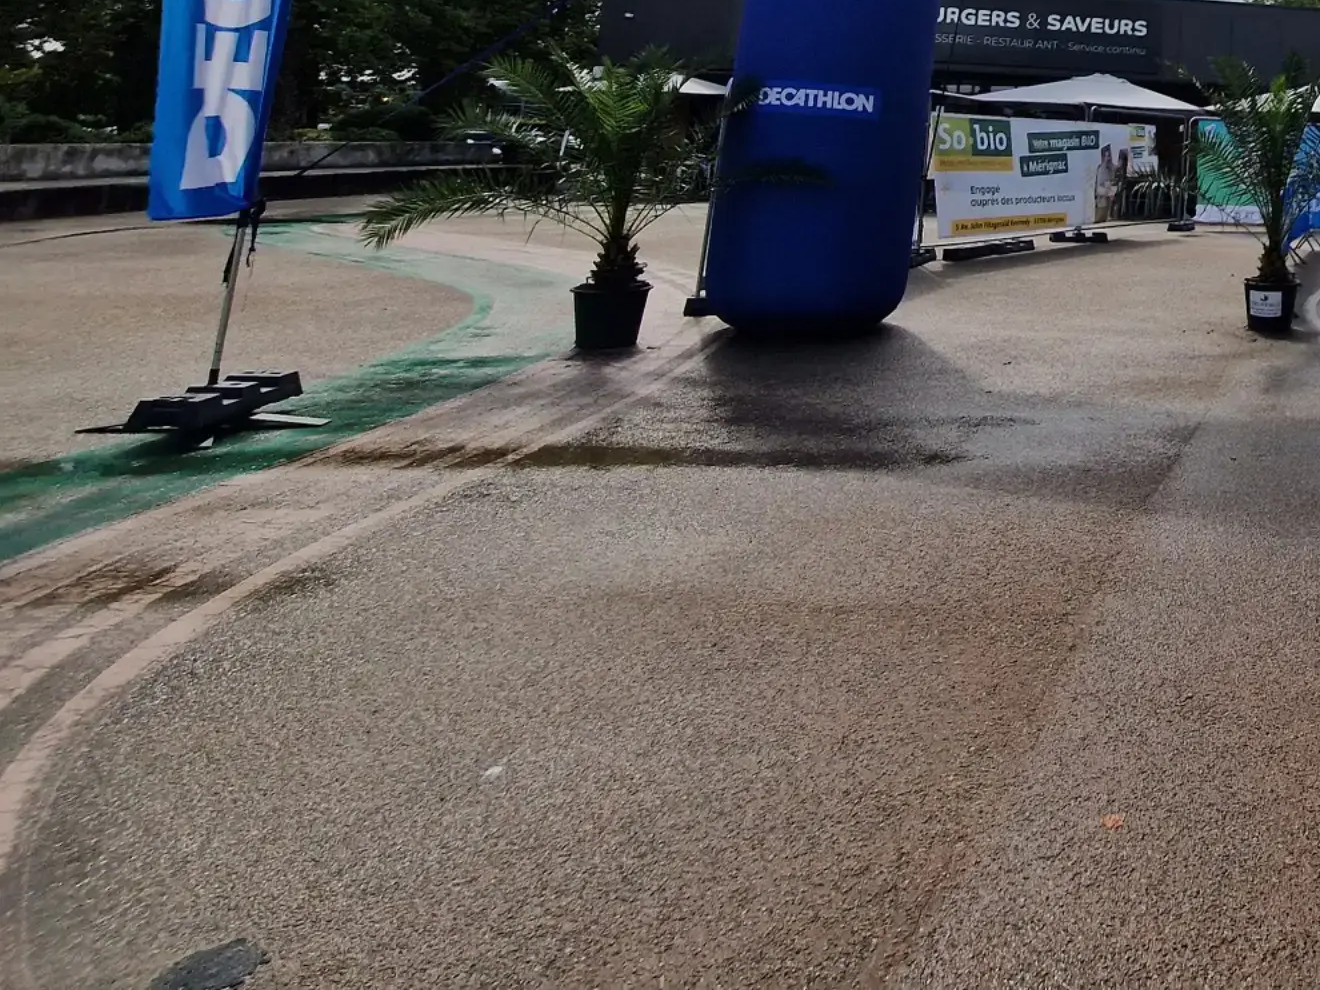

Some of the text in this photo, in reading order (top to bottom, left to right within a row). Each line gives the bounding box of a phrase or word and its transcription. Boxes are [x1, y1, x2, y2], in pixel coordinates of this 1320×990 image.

[1026, 13, 1041, 30] &
[1047, 14, 1148, 37] SAVEURS
[1067, 42, 1103, 54] Service
[1106, 45, 1147, 55] continu
[757, 87, 875, 113] DECATHLON
[1050, 136, 1080, 151] magasin
[1081, 135, 1096, 148] BIO
[1029, 159, 1066, 174] Mérignac
[970, 185, 1001, 196] Engagé
[970, 196, 999, 208] auprès
[1001, 196, 1014, 206] des
[1015, 195, 1056, 206] producteurs
